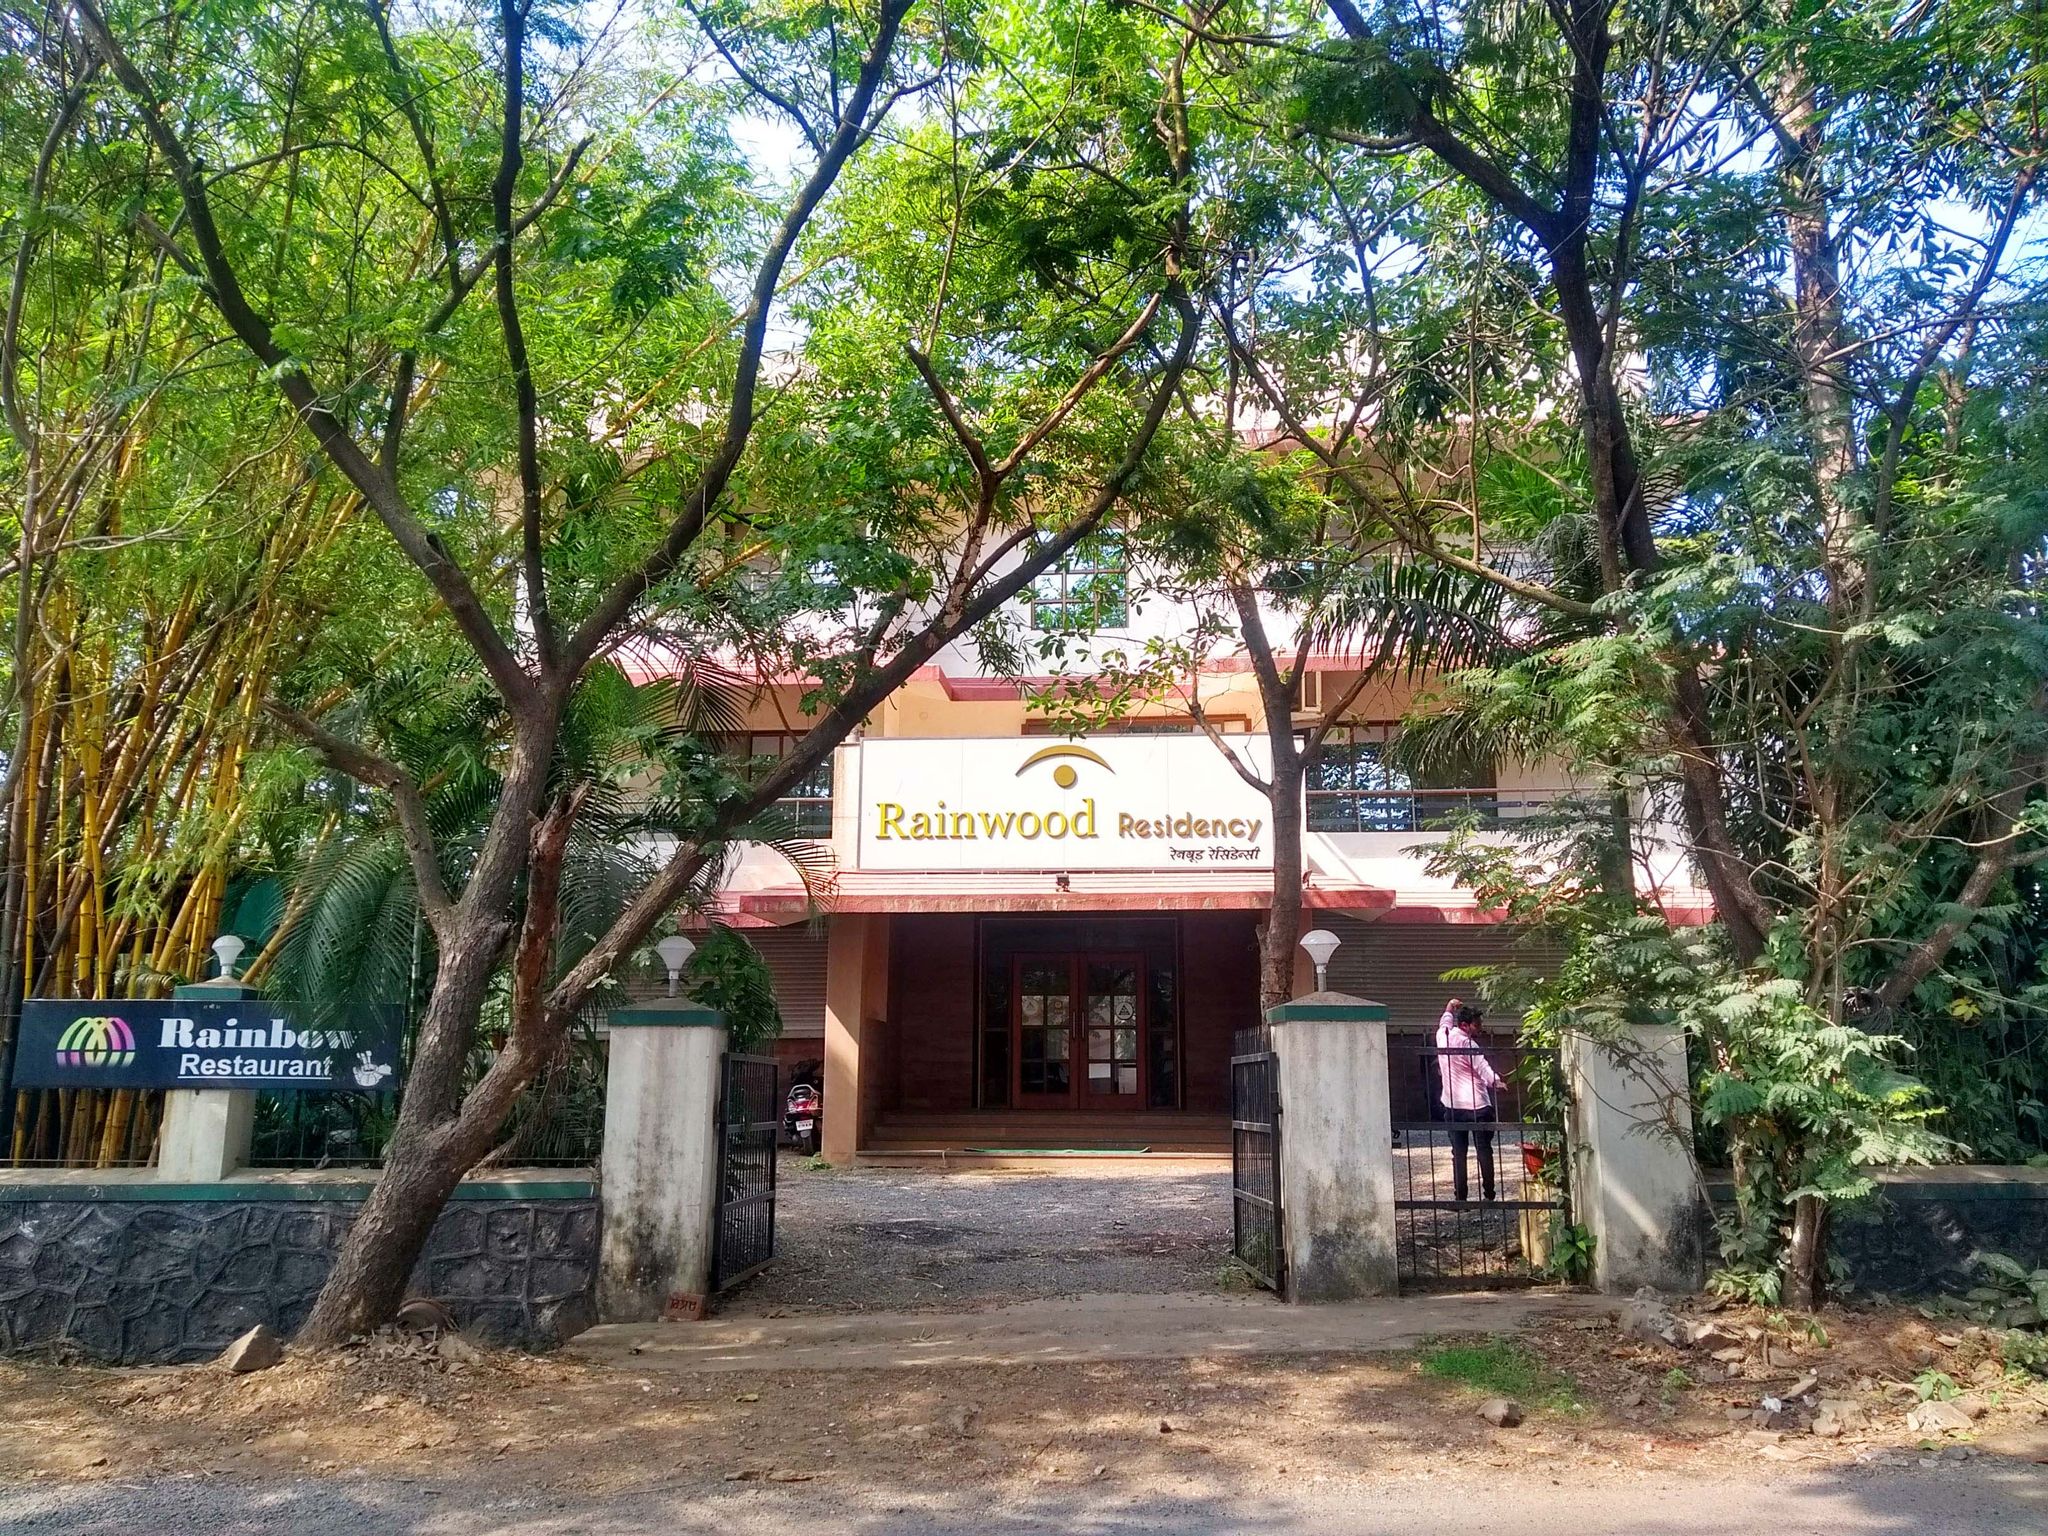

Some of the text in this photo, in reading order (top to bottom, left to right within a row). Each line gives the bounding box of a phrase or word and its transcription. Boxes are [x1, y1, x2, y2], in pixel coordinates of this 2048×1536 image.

[875, 798, 1262, 844] Rainwood Residency
[179, 1053, 333, 1077] Restaurant
